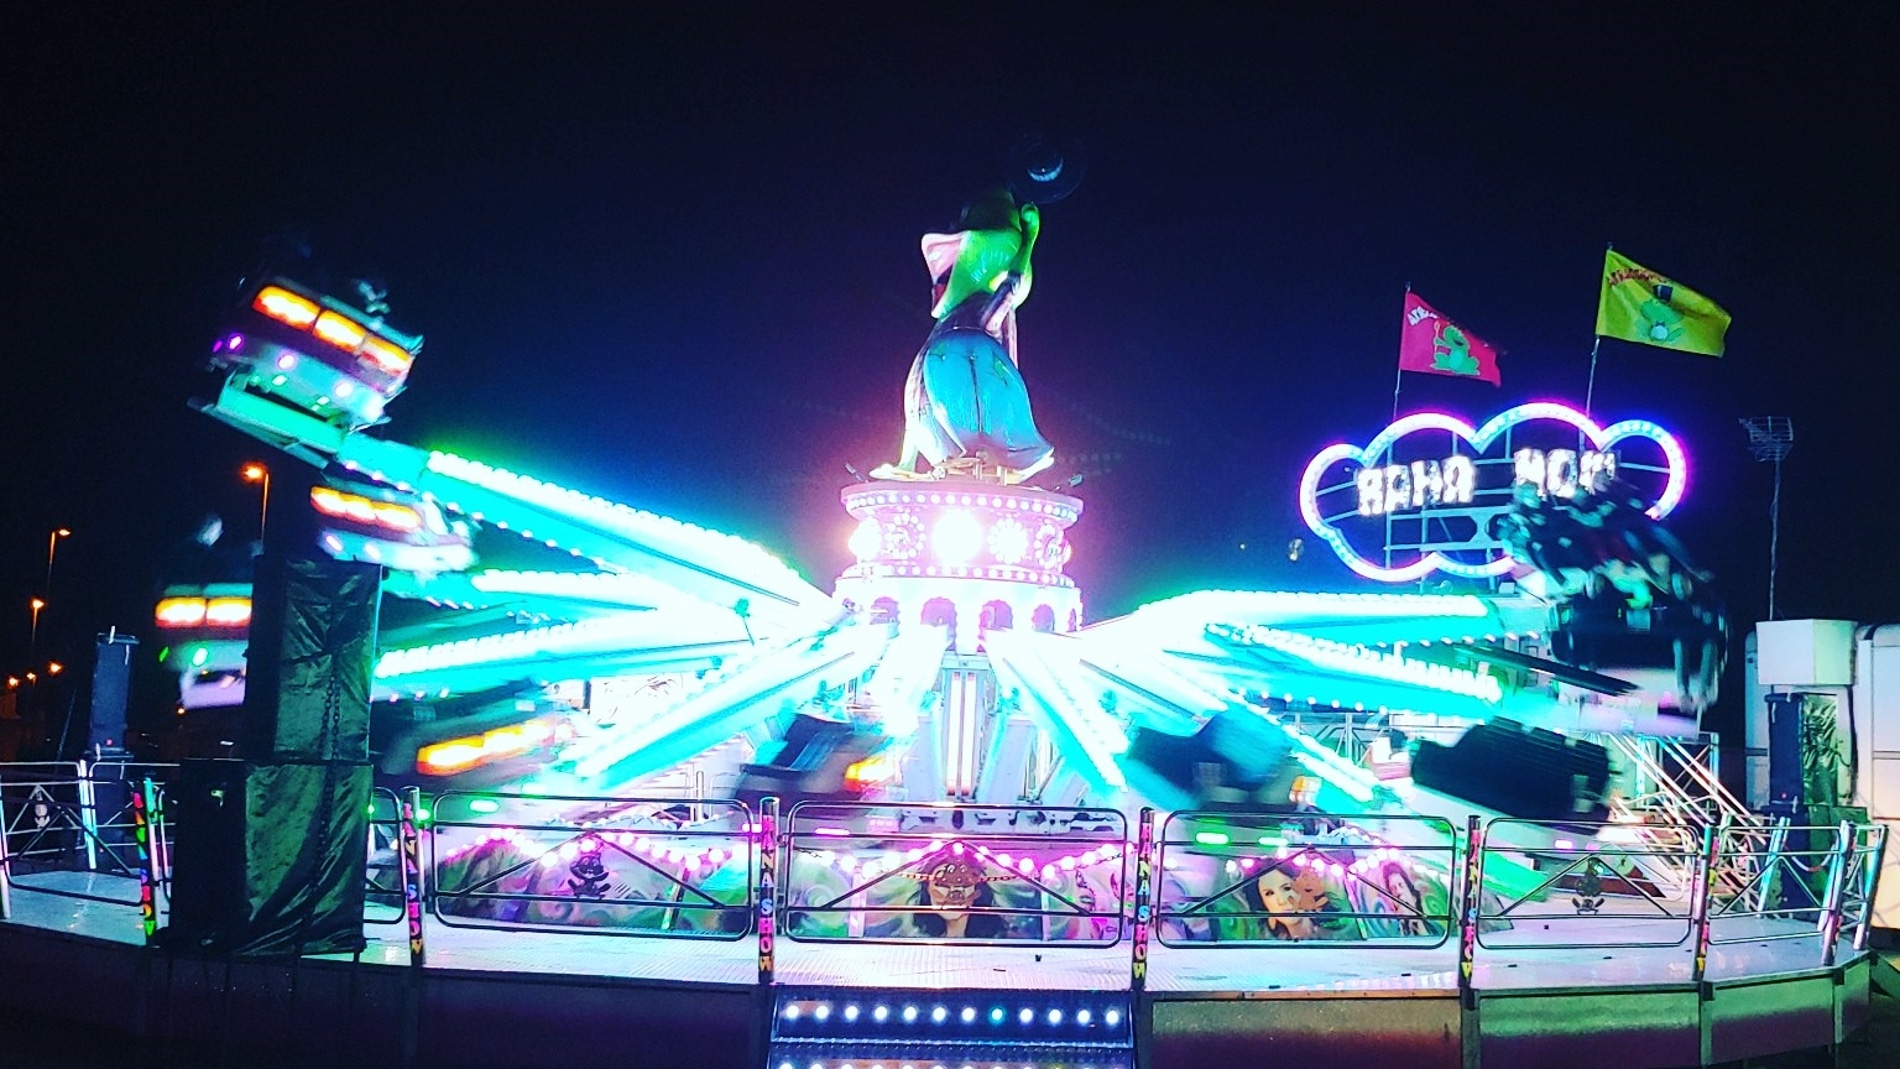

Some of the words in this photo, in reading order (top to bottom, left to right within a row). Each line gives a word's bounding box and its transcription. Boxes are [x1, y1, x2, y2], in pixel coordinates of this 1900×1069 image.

[760, 815, 775, 887] RANA
[1138, 822, 1154, 895] RANA
[758, 898, 774, 972] SHOW
[1132, 905, 1151, 979] SHOW
